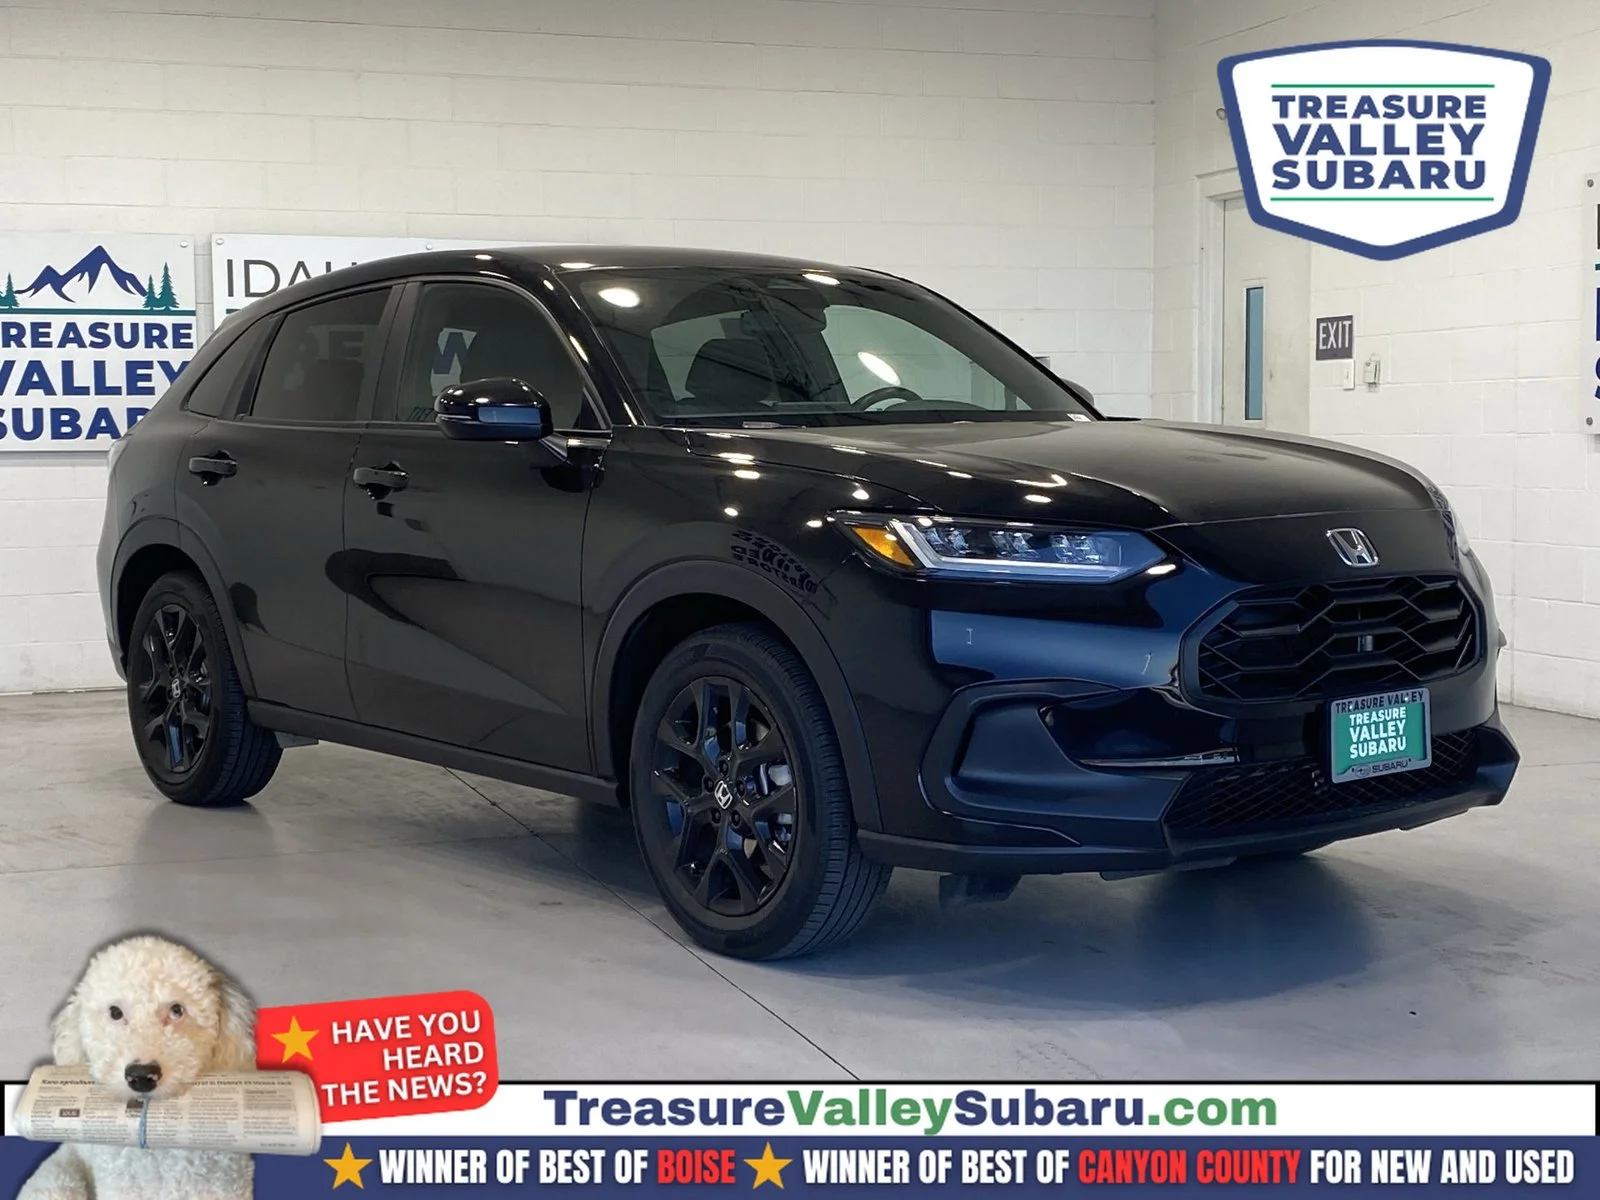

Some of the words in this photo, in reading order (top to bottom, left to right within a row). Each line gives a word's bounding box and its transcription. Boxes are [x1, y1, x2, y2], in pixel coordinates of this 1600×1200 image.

[227, 259, 357, 298] IDA
[1319, 321, 1351, 350] EXIT
[1335, 699, 1384, 714] TREASURE
[1349, 706, 1407, 726] TREASURE
[1349, 719, 1406, 743] VALLEY
[1349, 736, 1407, 759] SUBARU
[1372, 759, 1408, 774] SUBARU
